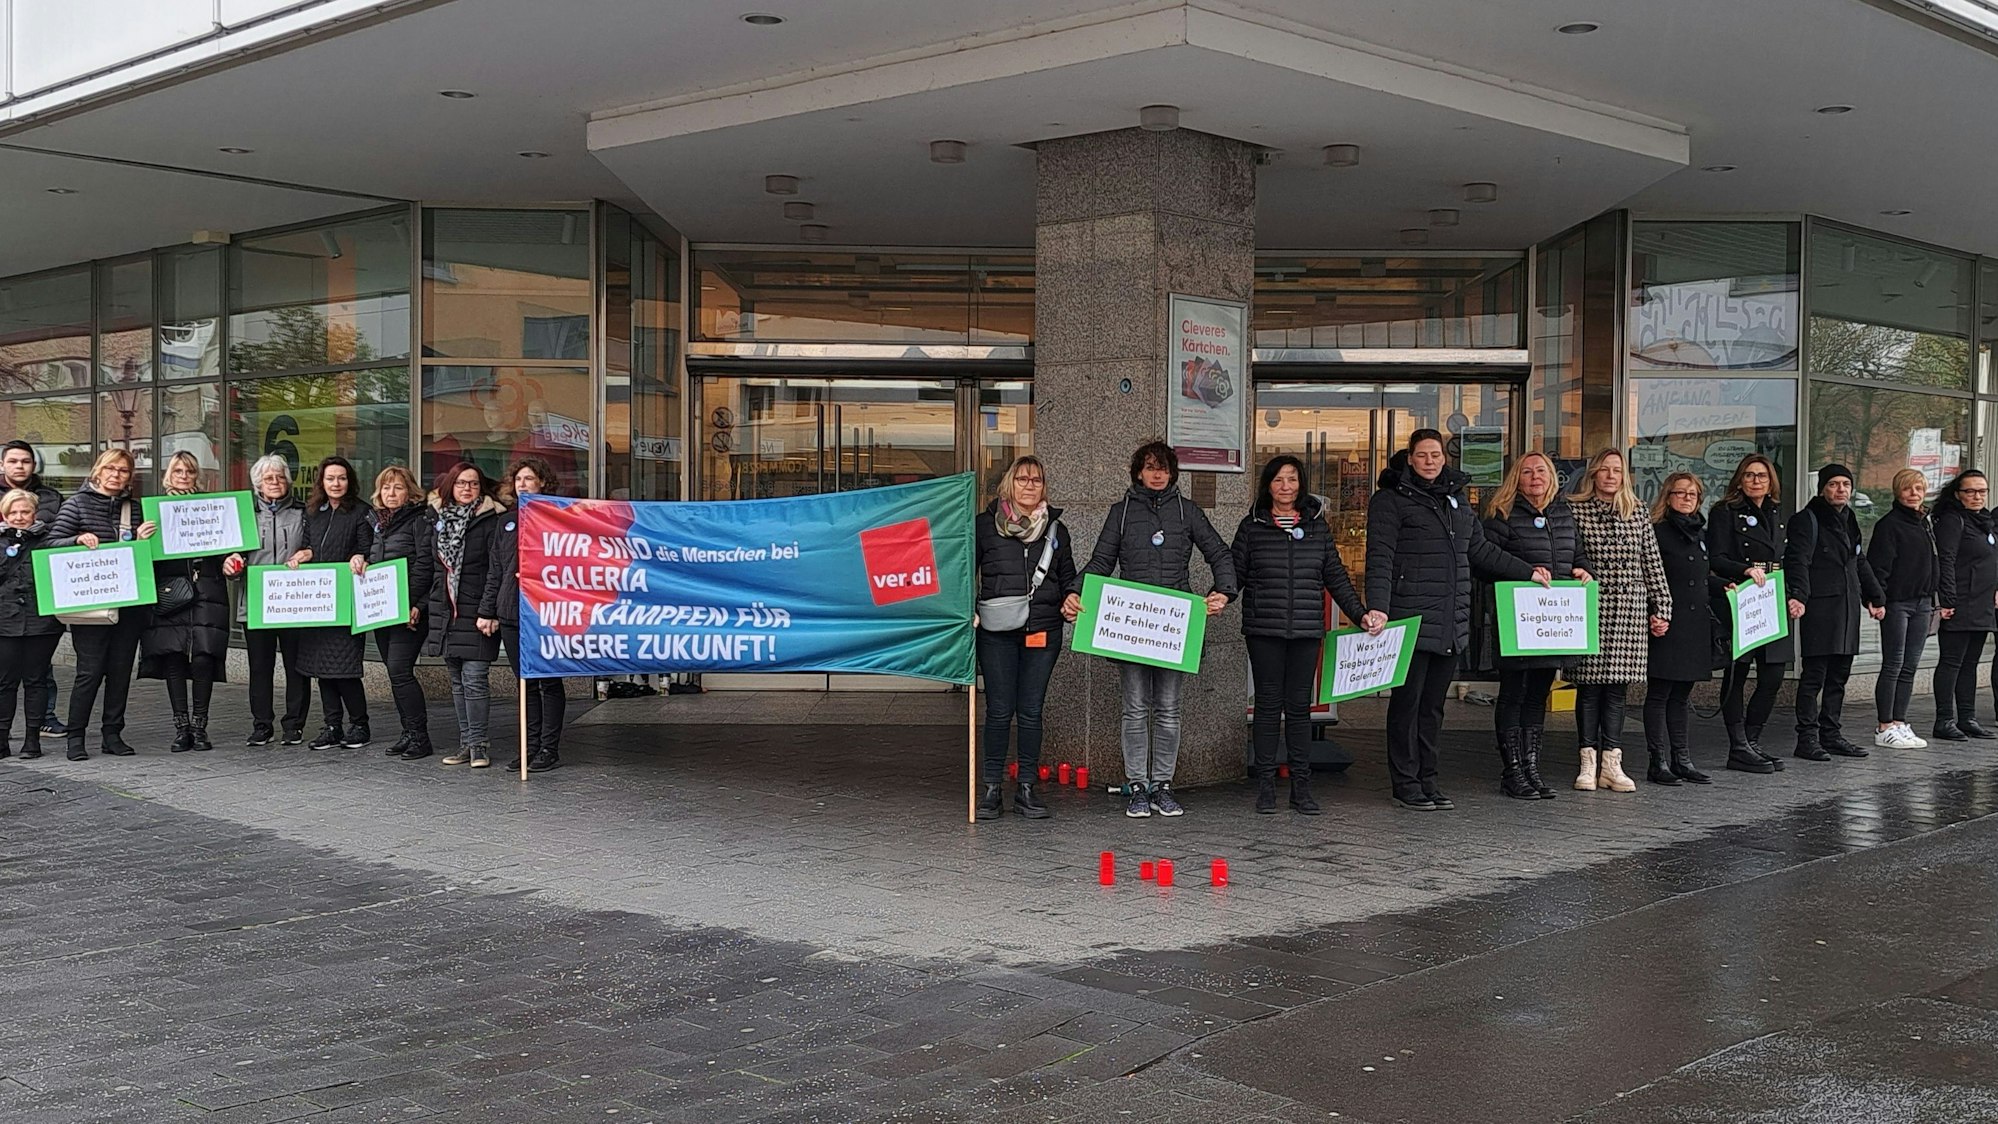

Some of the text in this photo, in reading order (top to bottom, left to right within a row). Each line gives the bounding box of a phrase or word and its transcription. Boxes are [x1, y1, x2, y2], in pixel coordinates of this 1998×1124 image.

[1182, 320, 1226, 338] Cleveres
[1182, 338, 1231, 356] Kärtchen.
[264, 415, 299, 483] 6
[172, 502, 225, 514] Wir wollen
[181, 516, 221, 527] bleiben!
[180, 529, 194, 538] Wie
[196, 528, 212, 539] geht
[189, 538, 218, 548] weiter?
[542, 532, 799, 563] WIR SIND die Menschen bei
[66, 558, 119, 570] Verzichtet
[70, 571, 119, 584] und doch
[268, 577, 333, 588] Wir zahlen für
[369, 573, 388, 583] wollen
[541, 565, 649, 592] GALERIA
[873, 566, 931, 588] ver.di
[73, 584, 119, 597] verloren!
[268, 589, 331, 601] die Fehler des
[1758, 588, 1774, 600] nicht
[1107, 595, 1185, 619] Wir zahlen für
[1537, 597, 1570, 607] Was ist
[266, 604, 334, 615] Managements!
[539, 599, 791, 628] WIR KÄMPFEN FÜR
[1104, 612, 1181, 635] die Fehler des
[1520, 612, 1584, 624] Siegburg ohne
[1098, 627, 1181, 651] Managements!
[1536, 628, 1574, 638] Galeria?
[540, 635, 776, 661] UNSERE ZUKUNFT!
[1356, 640, 1386, 652] Was ist
[1339, 652, 1397, 670] Siegburg ohne
[1349, 667, 1382, 682] Galeria?
